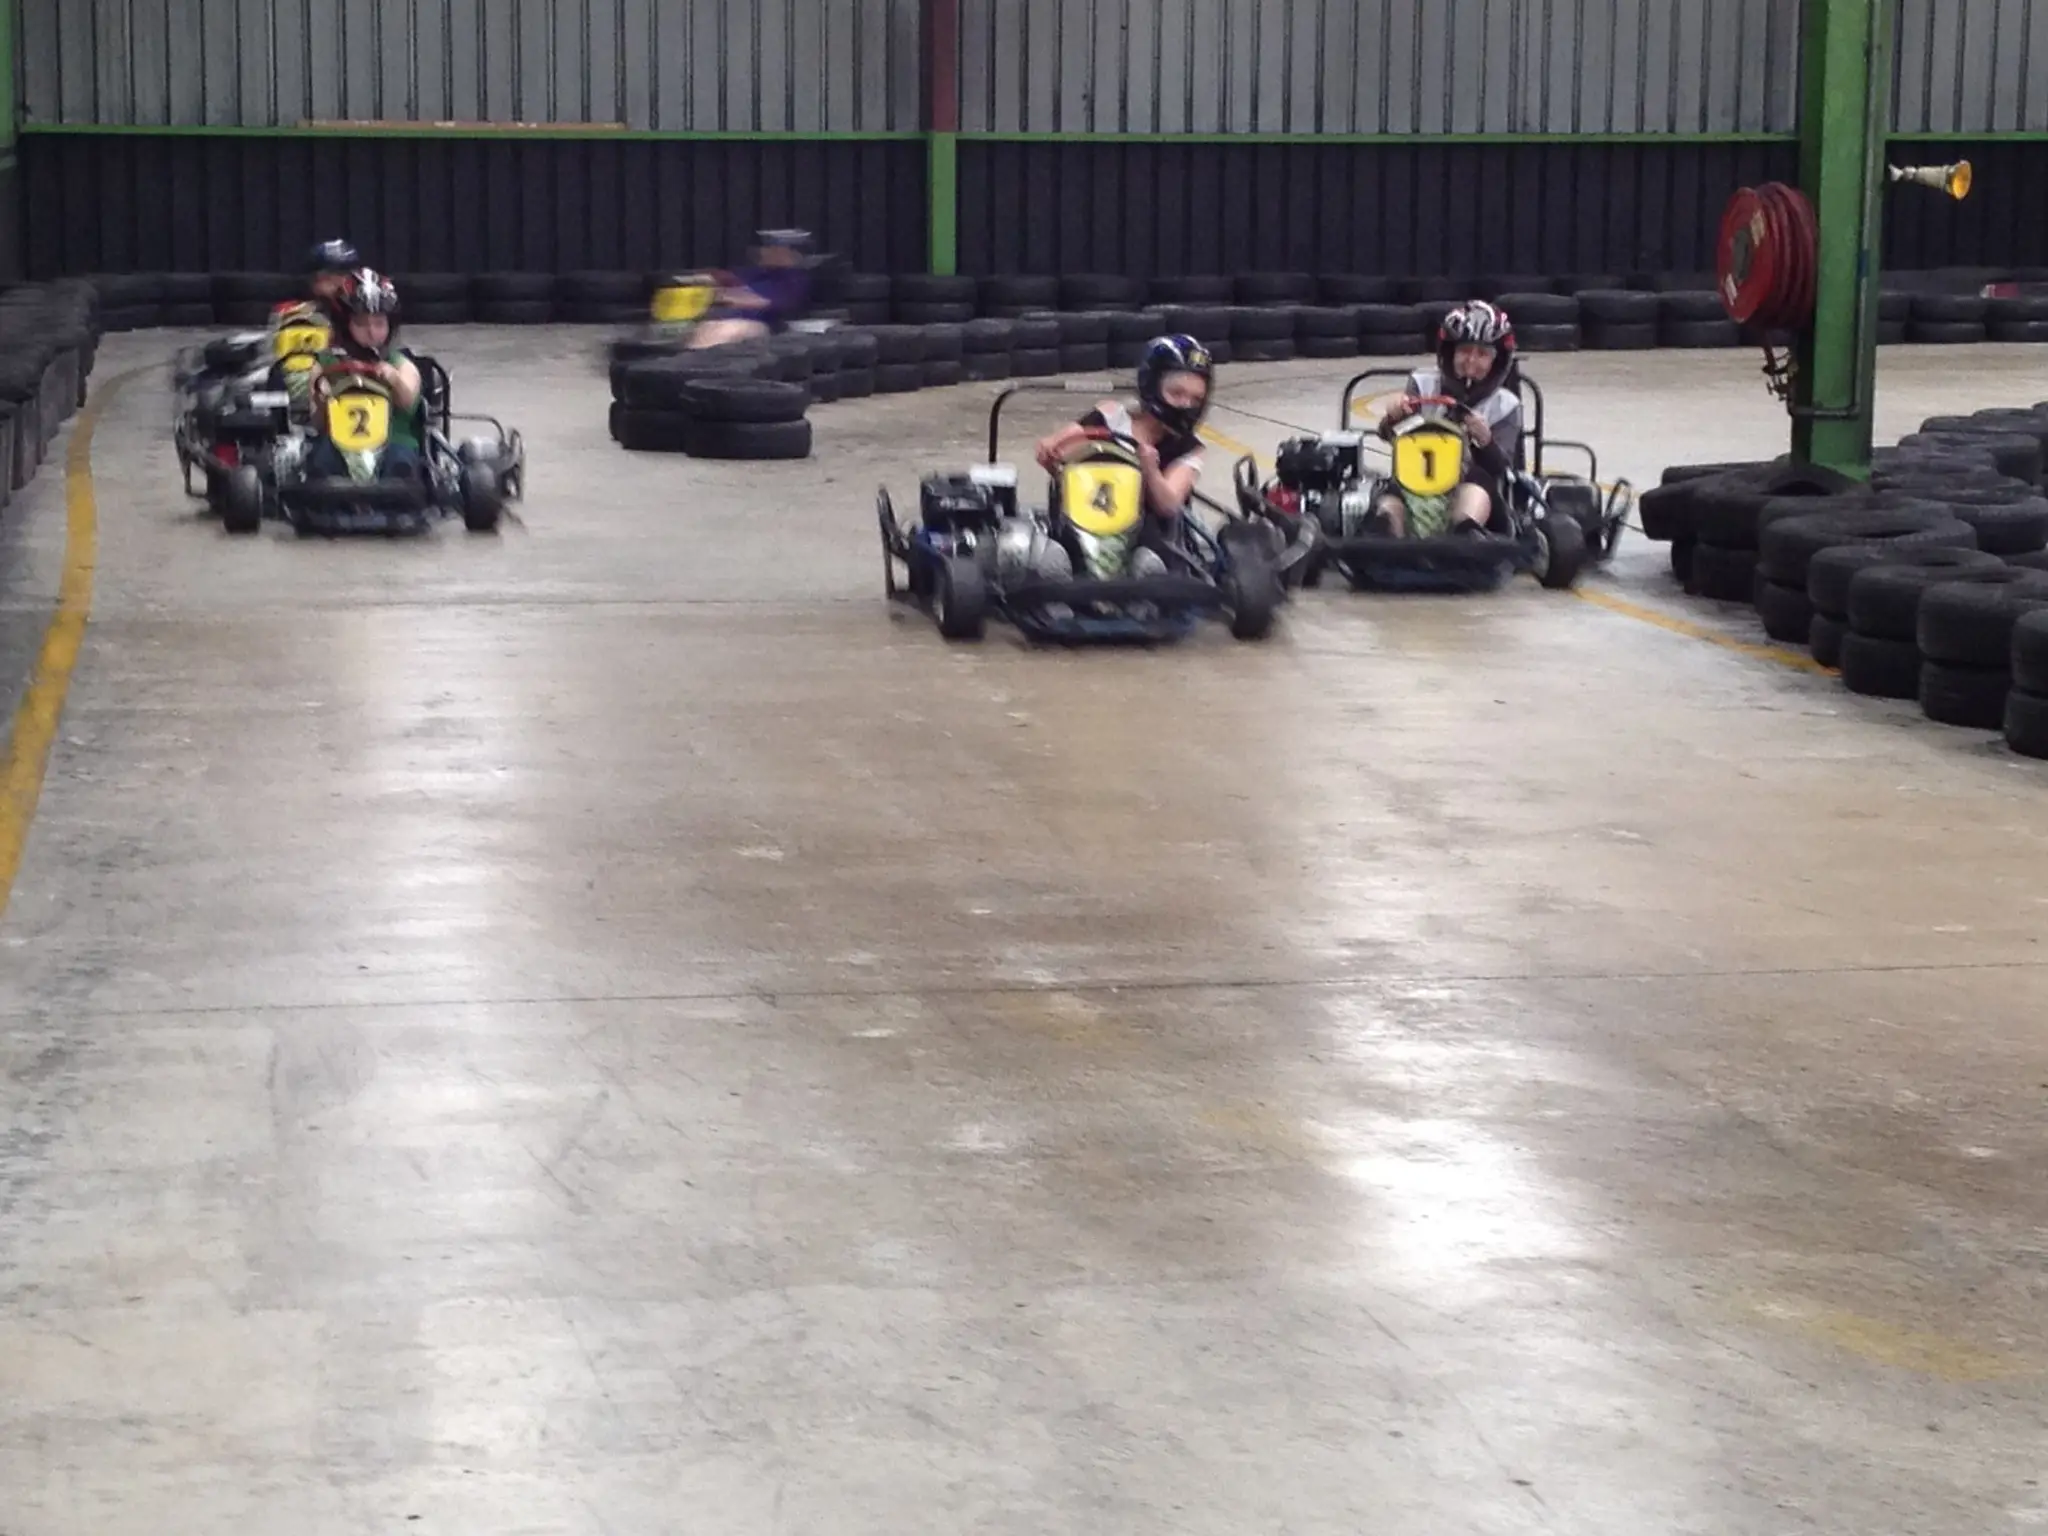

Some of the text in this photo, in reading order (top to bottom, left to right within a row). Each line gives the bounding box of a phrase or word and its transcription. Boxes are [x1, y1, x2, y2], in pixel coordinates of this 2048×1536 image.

[348, 407, 371, 437] 2
[1420, 448, 1436, 481] 1
[1091, 481, 1118, 518] 4
